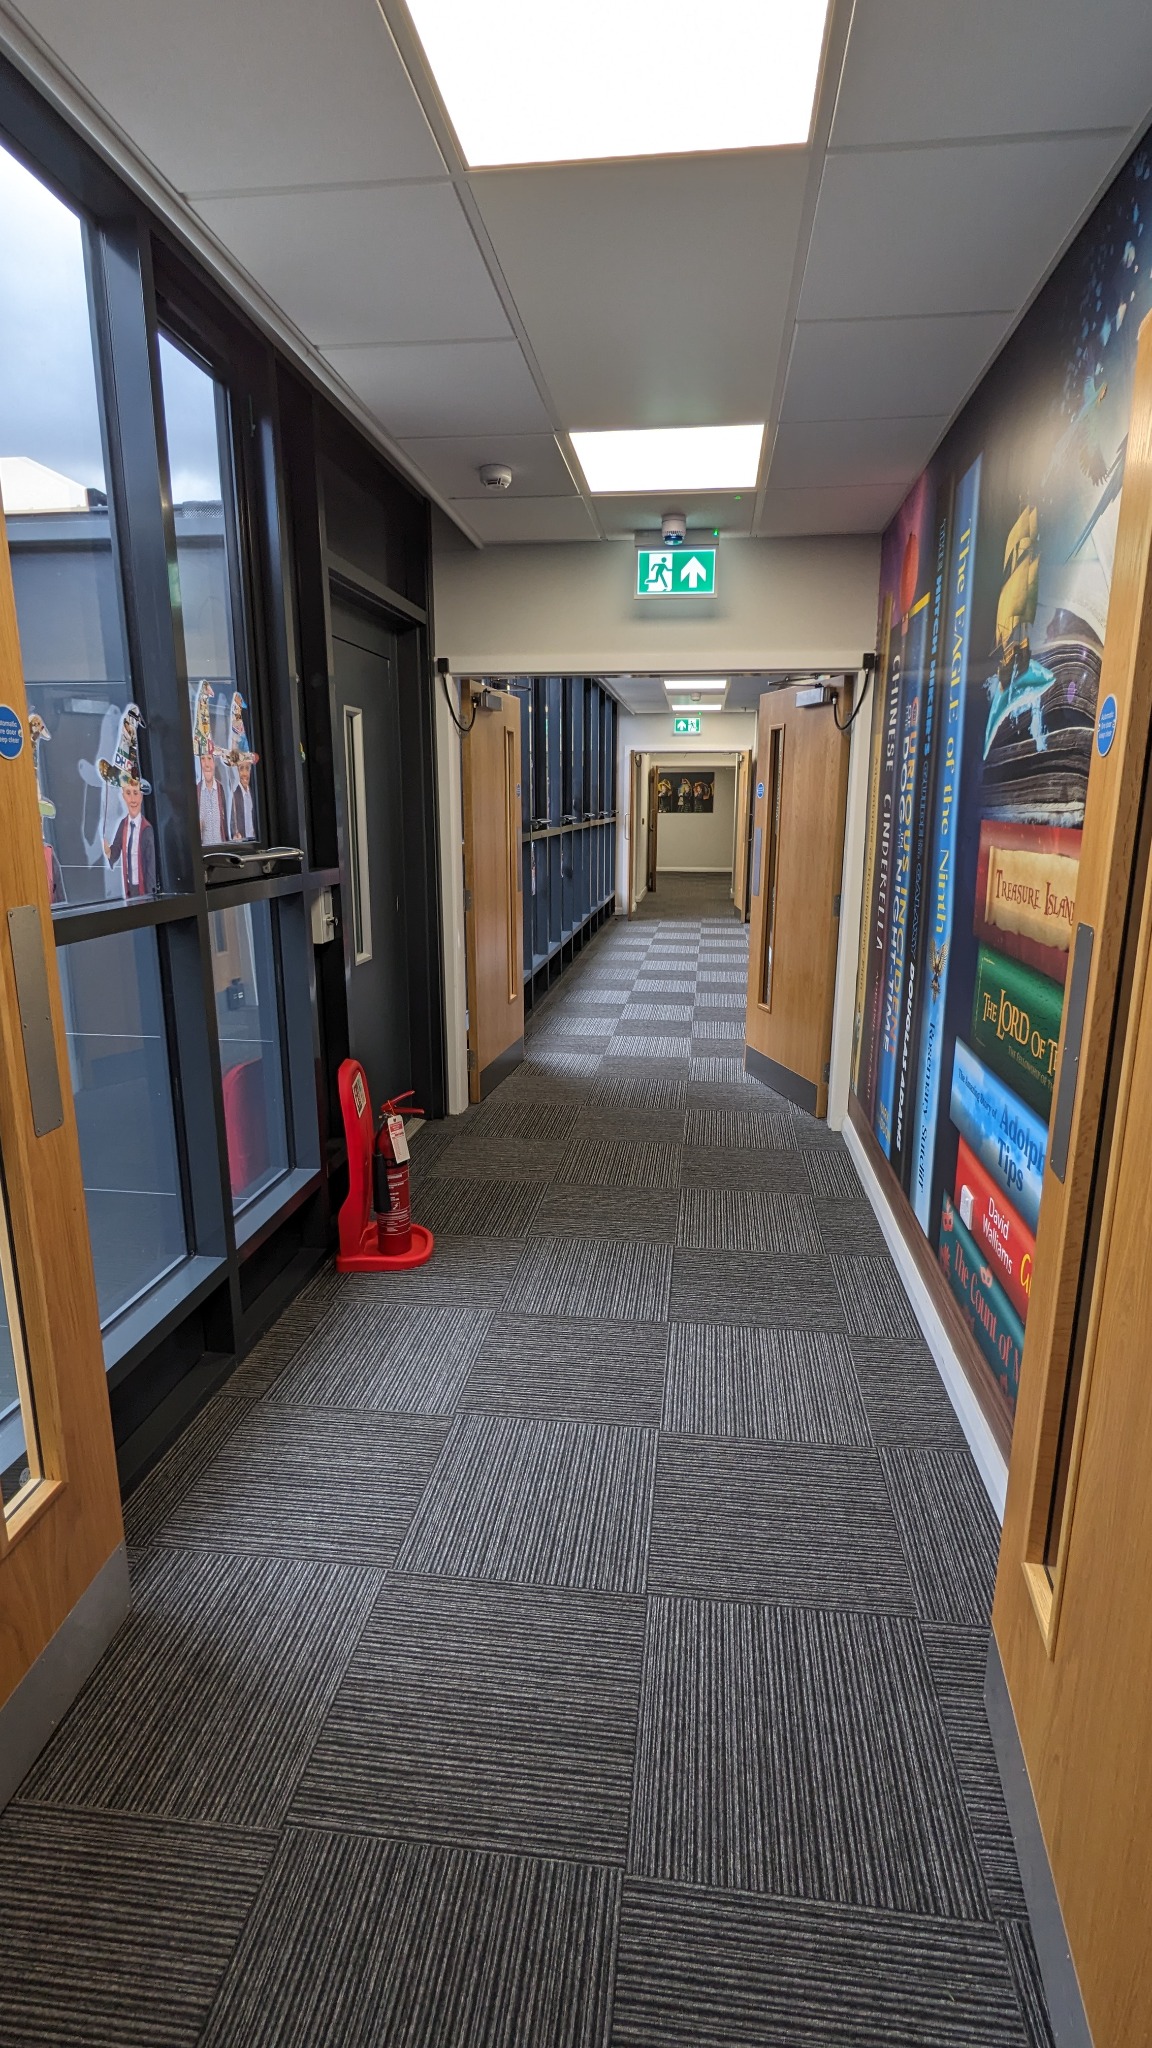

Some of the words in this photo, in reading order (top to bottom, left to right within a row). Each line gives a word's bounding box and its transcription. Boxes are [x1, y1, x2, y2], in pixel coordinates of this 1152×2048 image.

[957, 518, 972, 594] The
[931, 574, 942, 655] HITCH
[948, 604, 966, 724] EAGLE
[885, 654, 901, 772] CHINESE
[924, 659, 936, 756] HIKER'S
[898, 736, 910, 824] DOG
[902, 696, 920, 873] CURIOUS
[945, 736, 955, 774] of
[941, 784, 953, 835] the
[876, 793, 892, 950] CINDERELLA
[935, 849, 949, 933] Ninth
[995, 869, 1041, 910] TREASURE
[1044, 881, 1075, 926] ISLAN
[883, 858, 902, 1053] NIGHT-TIME
[888, 886, 908, 1056] INCIDENT
[902, 961, 915, 1072] DOUGLAS
[982, 991, 998, 1023] THE
[995, 988, 1030, 1045] LORD
[1030, 1030, 1046, 1060] OF
[896, 1070, 906, 1152] ADAMS
[921, 1021, 936, 1120] Rosemary
[997, 1136, 1024, 1192] Tips
[999, 1103, 1045, 1176] Adolph
[982, 1213, 1013, 1276] Walliams
[988, 1196, 1010, 1241] David
[954, 1239, 969, 1290] The
[970, 1271, 998, 1344] Count
[998, 1333, 1013, 1368] of
